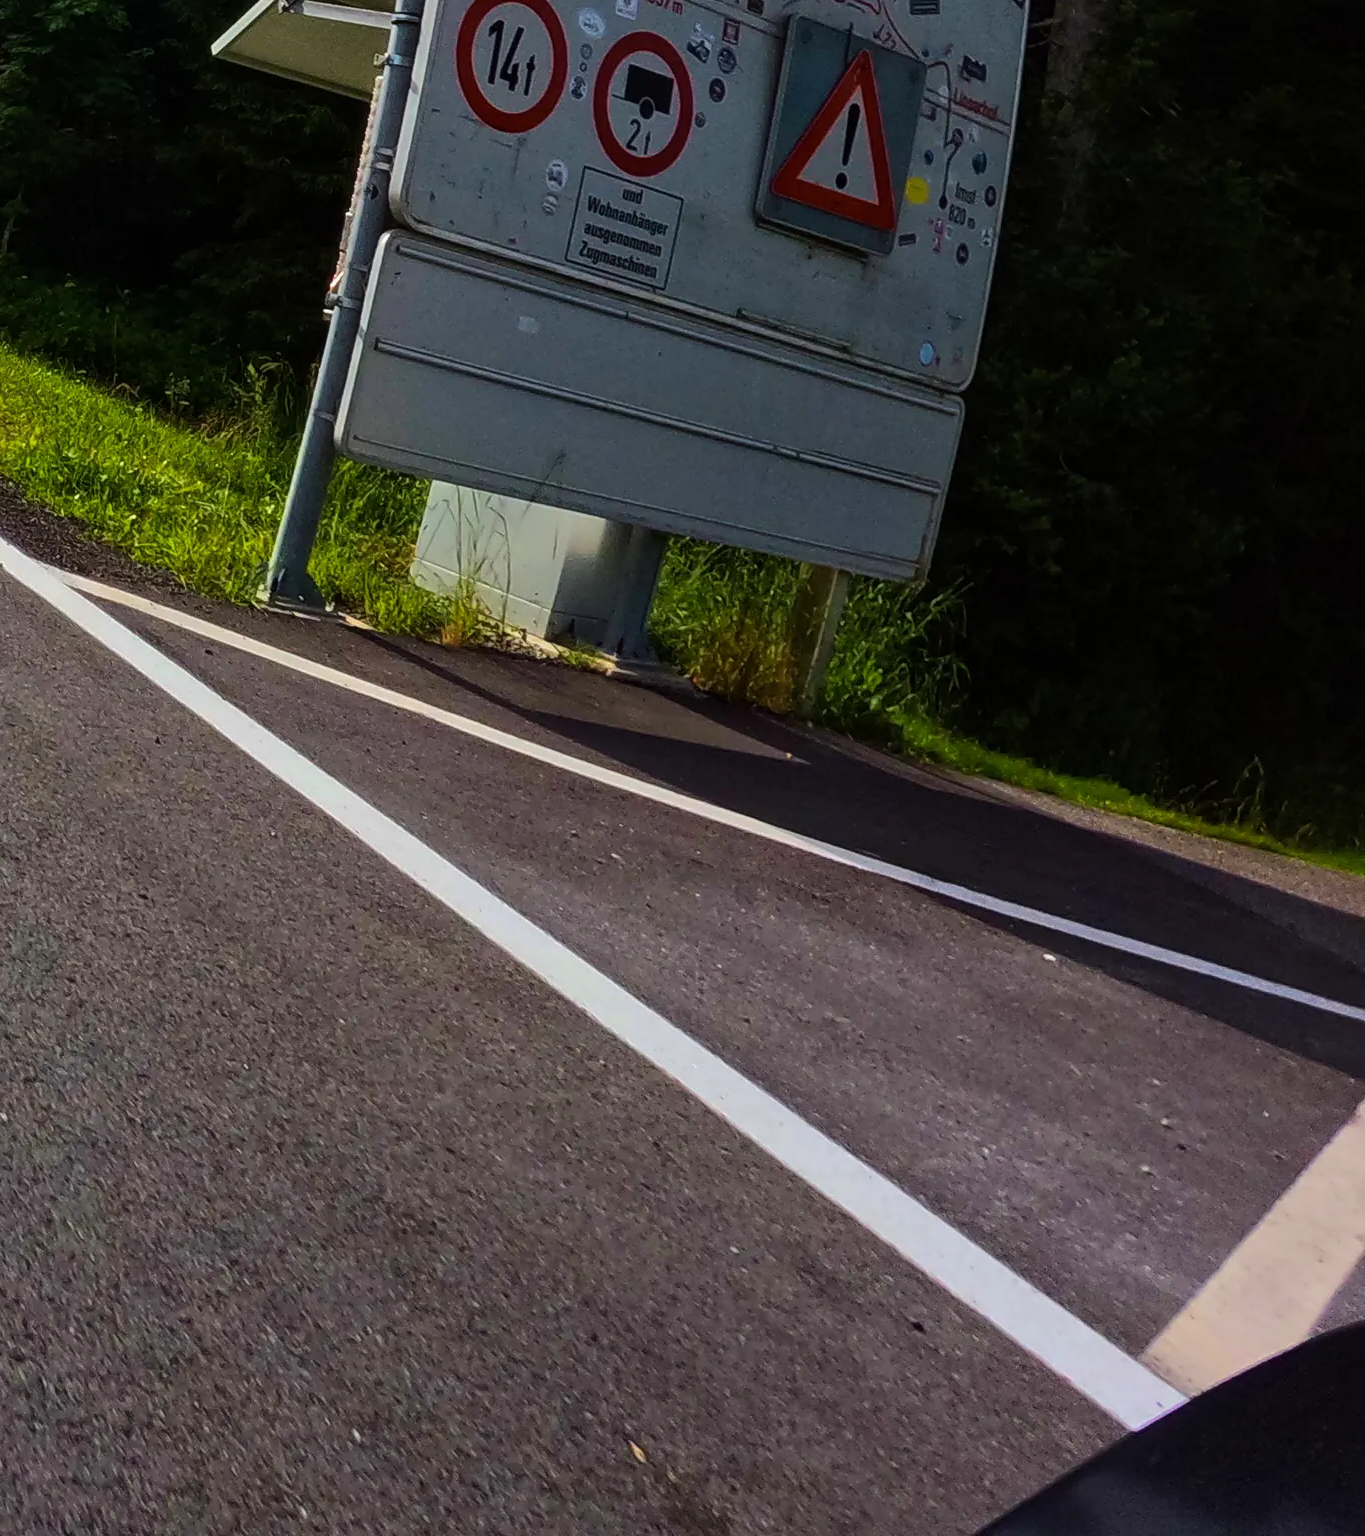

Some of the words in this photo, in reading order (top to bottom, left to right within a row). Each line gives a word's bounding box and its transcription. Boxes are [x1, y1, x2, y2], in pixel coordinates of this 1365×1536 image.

[622, 188, 645, 205] und
[587, 195, 669, 236] Wohnanhänger
[584, 223, 662, 257] ausgenommen
[579, 240, 658, 279] Zugmaschinen
